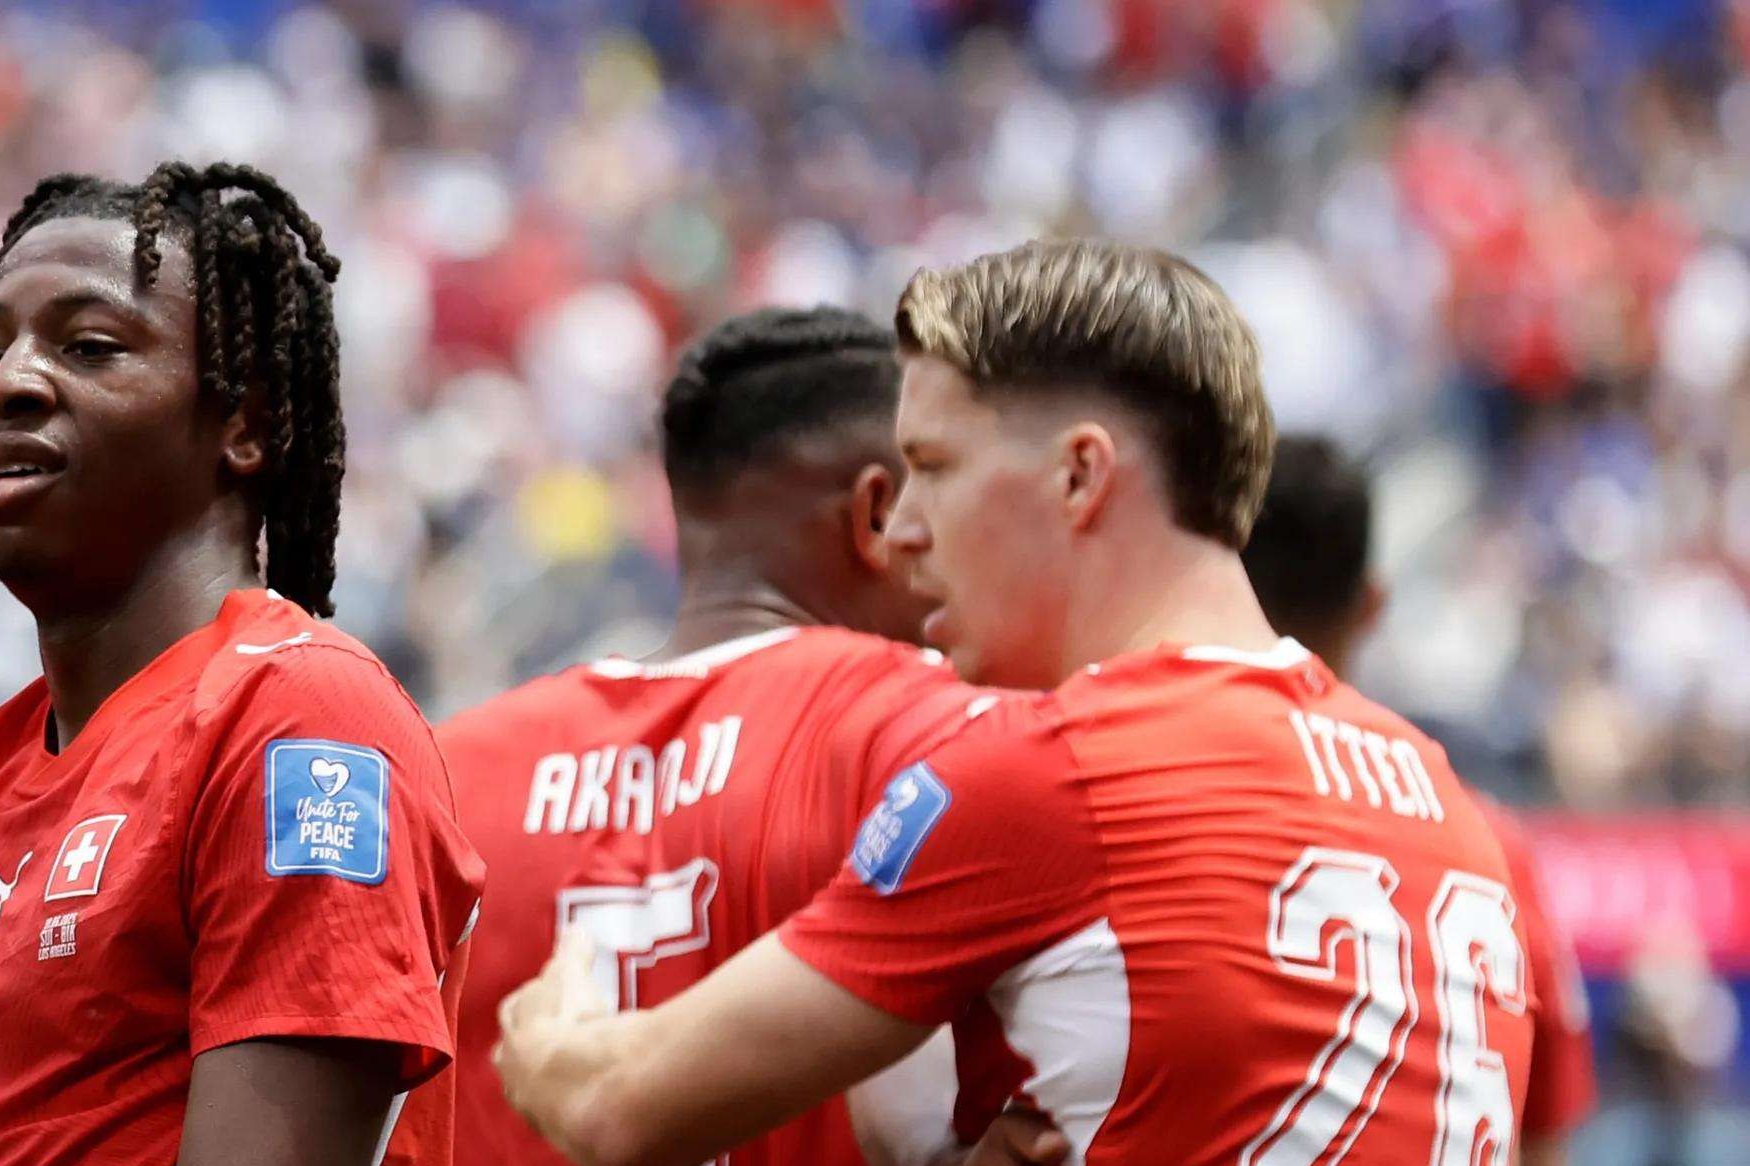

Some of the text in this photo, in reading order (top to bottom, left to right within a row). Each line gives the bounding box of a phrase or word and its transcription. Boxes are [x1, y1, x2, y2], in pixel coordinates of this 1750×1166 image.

[523, 716, 742, 834] AKANJI
[1291, 710, 1444, 823] ITTEN
[296, 797, 361, 823] Unite For
[299, 821, 355, 850] PEACE
[310, 847, 342, 861] FIFA
